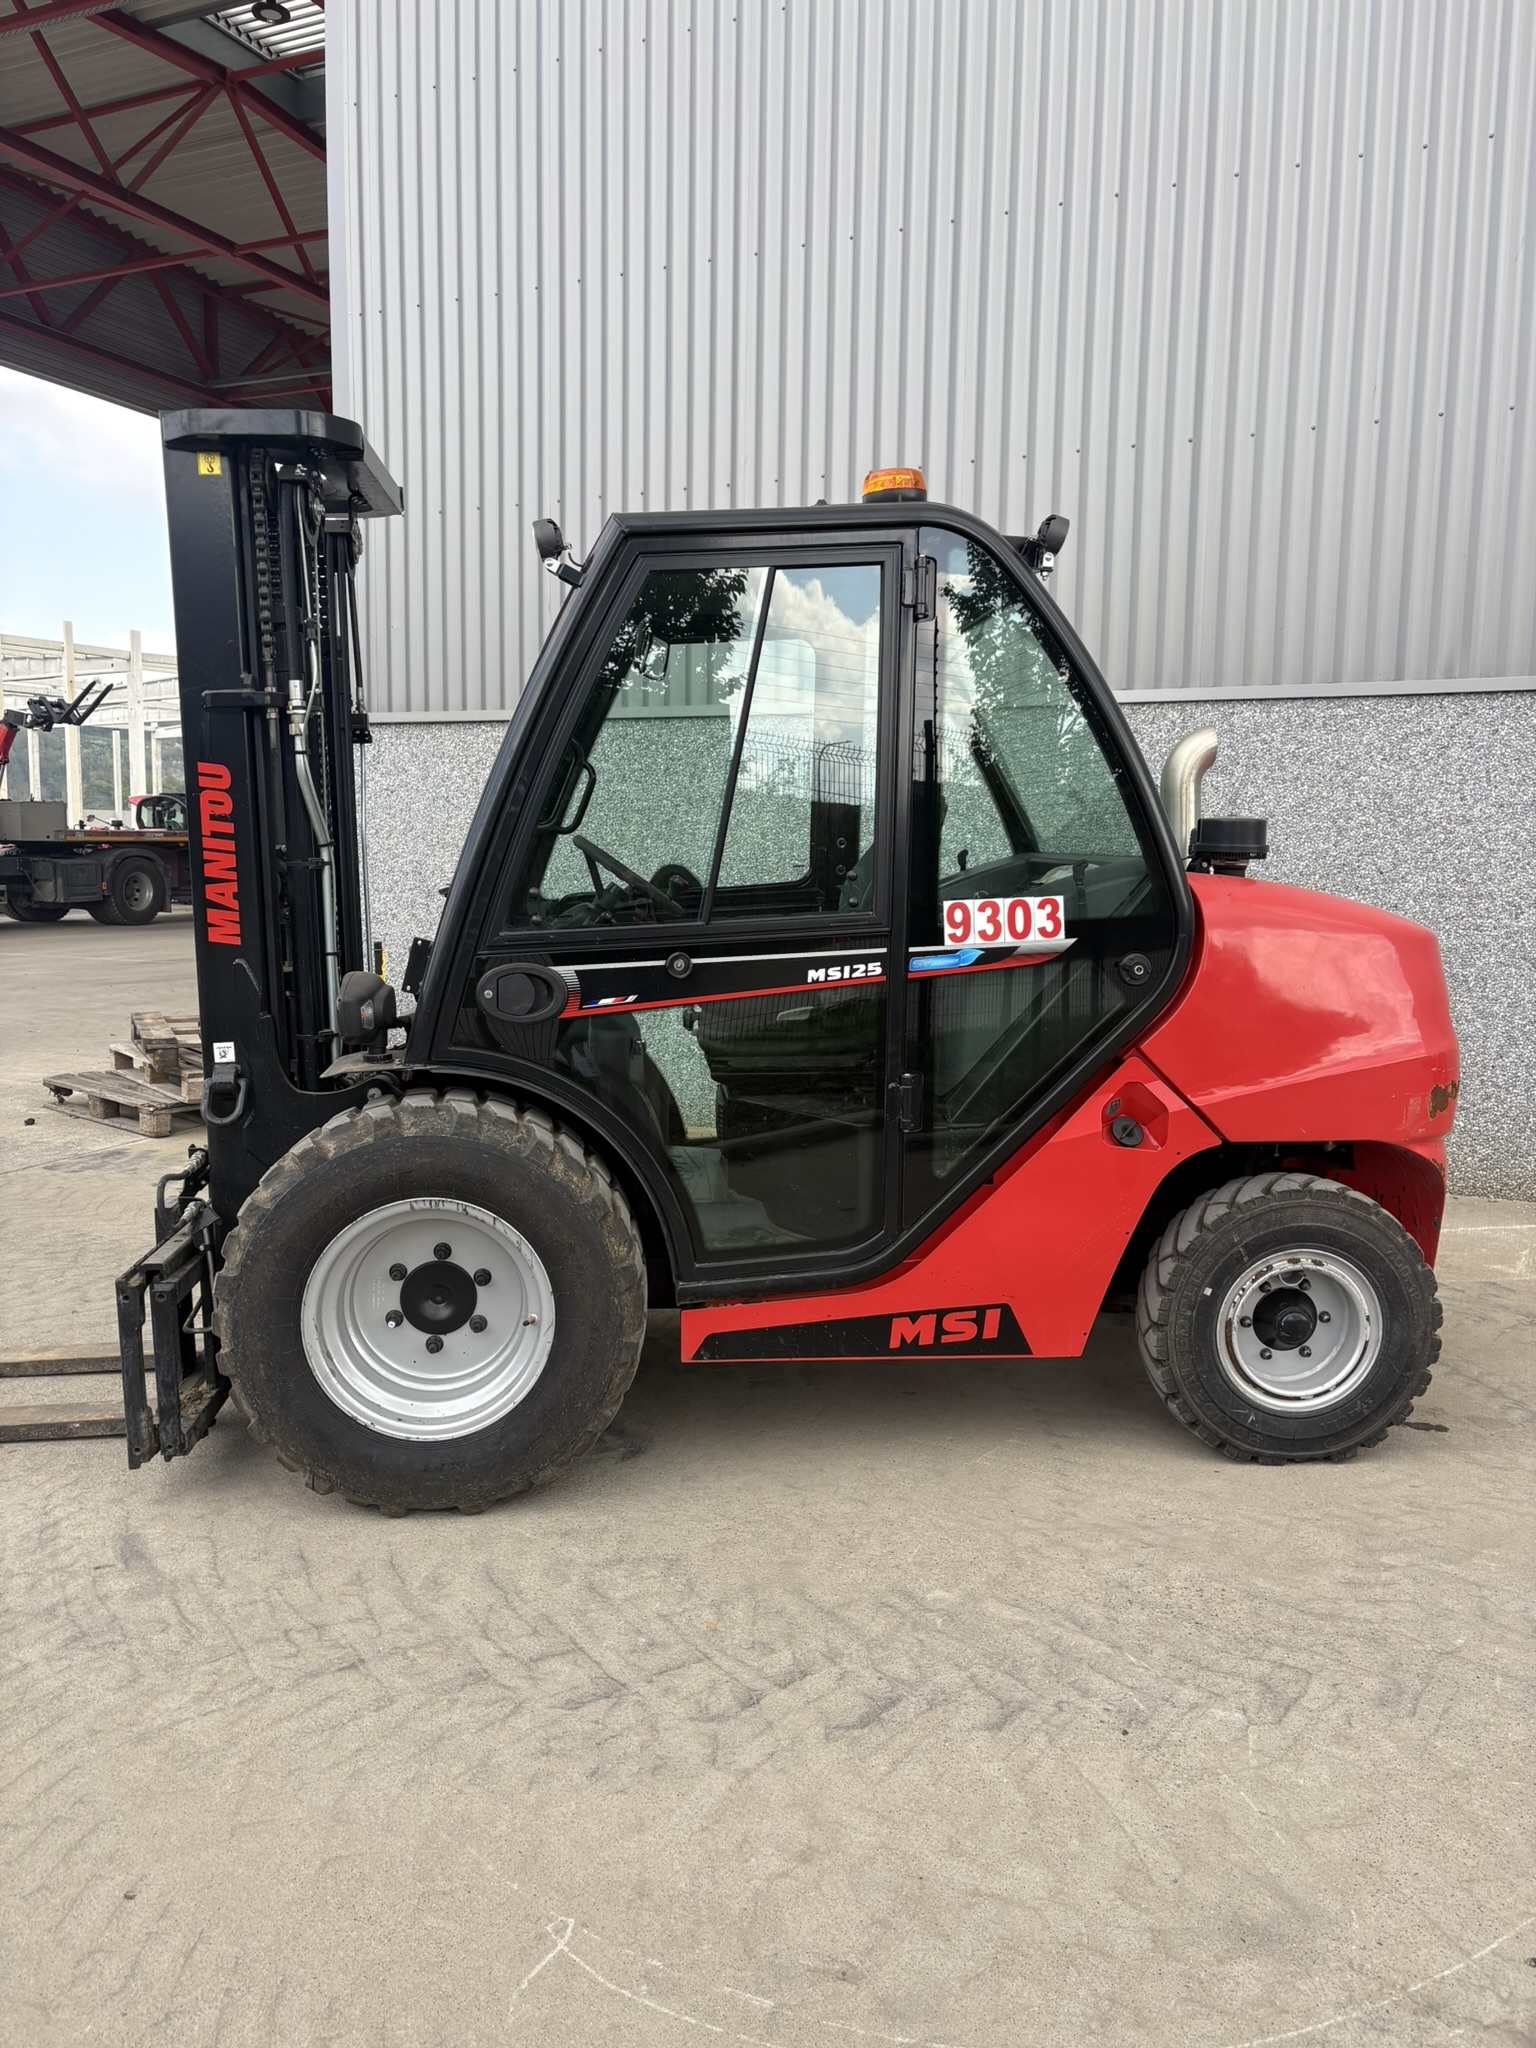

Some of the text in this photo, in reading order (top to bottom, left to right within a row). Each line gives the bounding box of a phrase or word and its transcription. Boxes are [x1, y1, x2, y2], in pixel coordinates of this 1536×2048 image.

[197, 761, 241, 945] MANITOU
[946, 898, 1062, 943] 9303
[807, 962, 882, 983] MSI25
[889, 1308, 1002, 1349] MSI
